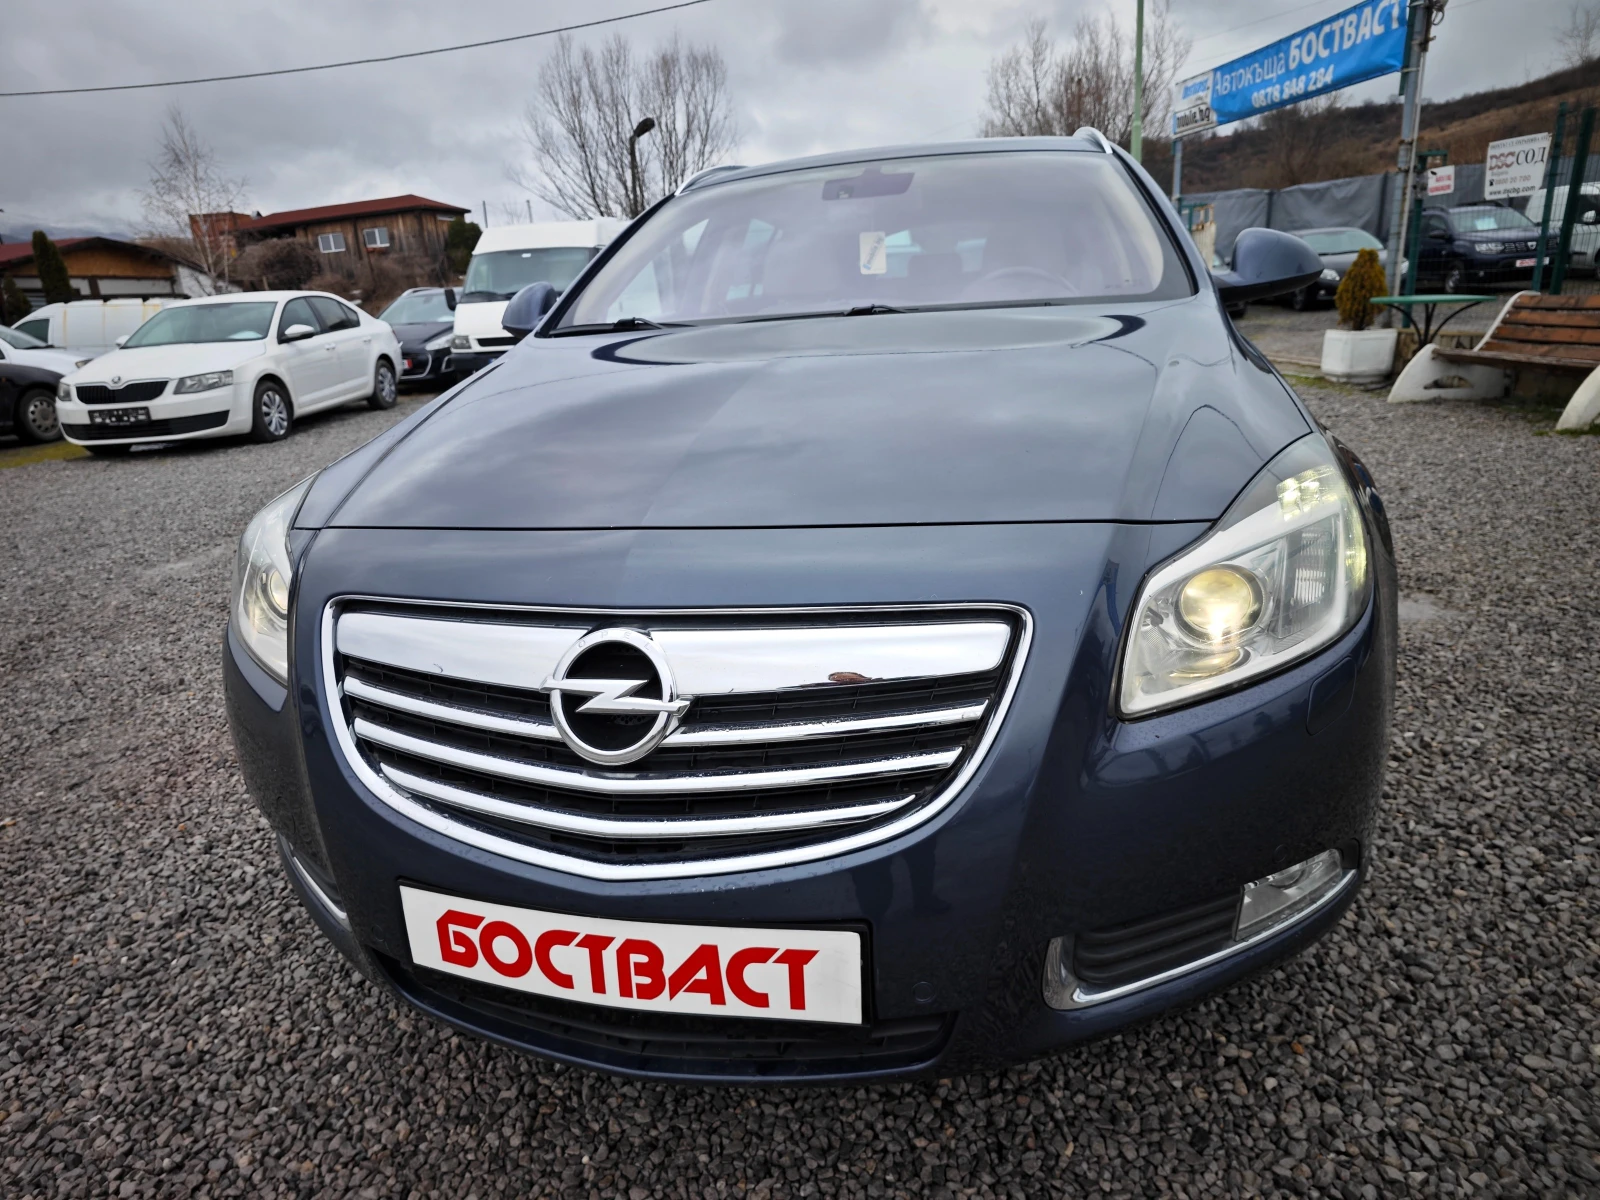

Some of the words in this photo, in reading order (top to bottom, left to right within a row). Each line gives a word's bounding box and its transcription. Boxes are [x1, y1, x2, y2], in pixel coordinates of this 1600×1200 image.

[1288, 0, 1401, 69] БОСТВАСТ
[1252, 84, 1281, 109] 0878
[1308, 64, 1335, 92] 284
[577, 630, 651, 651] OPEL
[436, 909, 820, 1011] БОСТВАСТ
